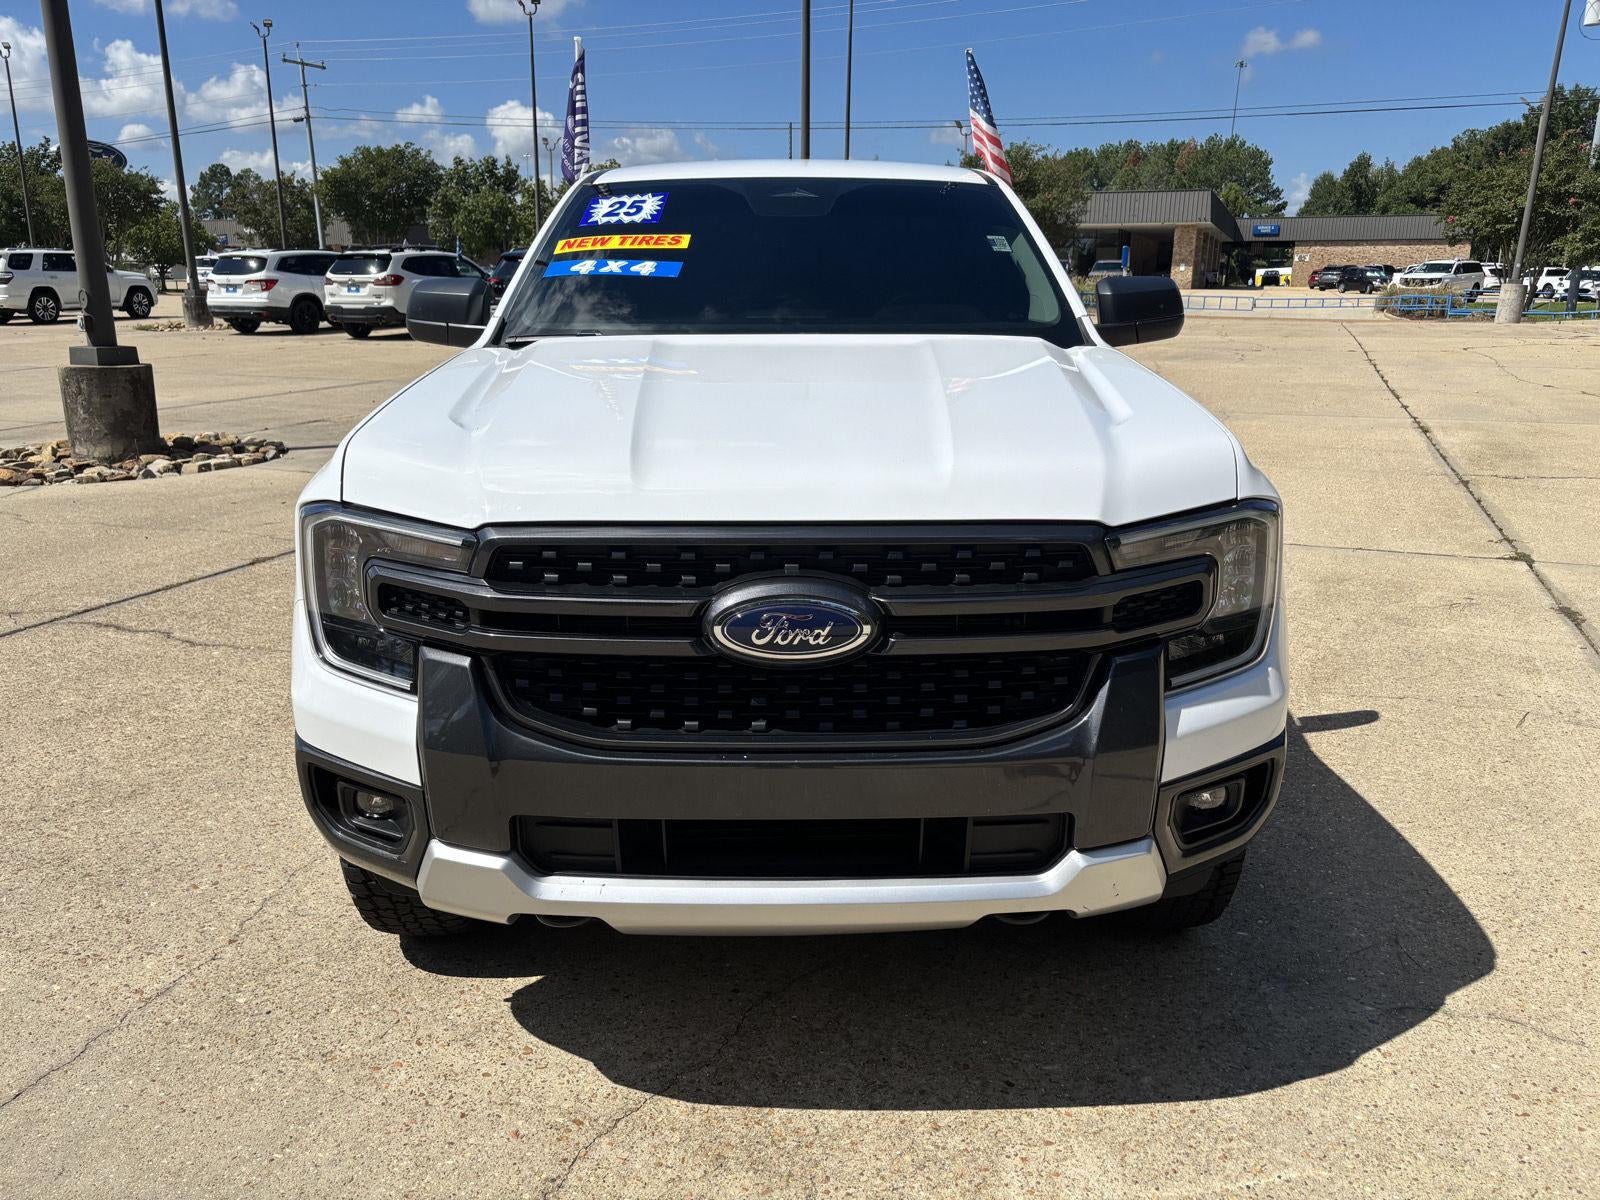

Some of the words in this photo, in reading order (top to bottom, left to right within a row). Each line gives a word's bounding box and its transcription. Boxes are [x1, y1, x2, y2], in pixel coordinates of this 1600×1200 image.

[601, 200, 647, 218] 25
[560, 236, 612, 251] NEW
[618, 235, 683, 247] TIRES
[751, 612, 833, 645] Ford
